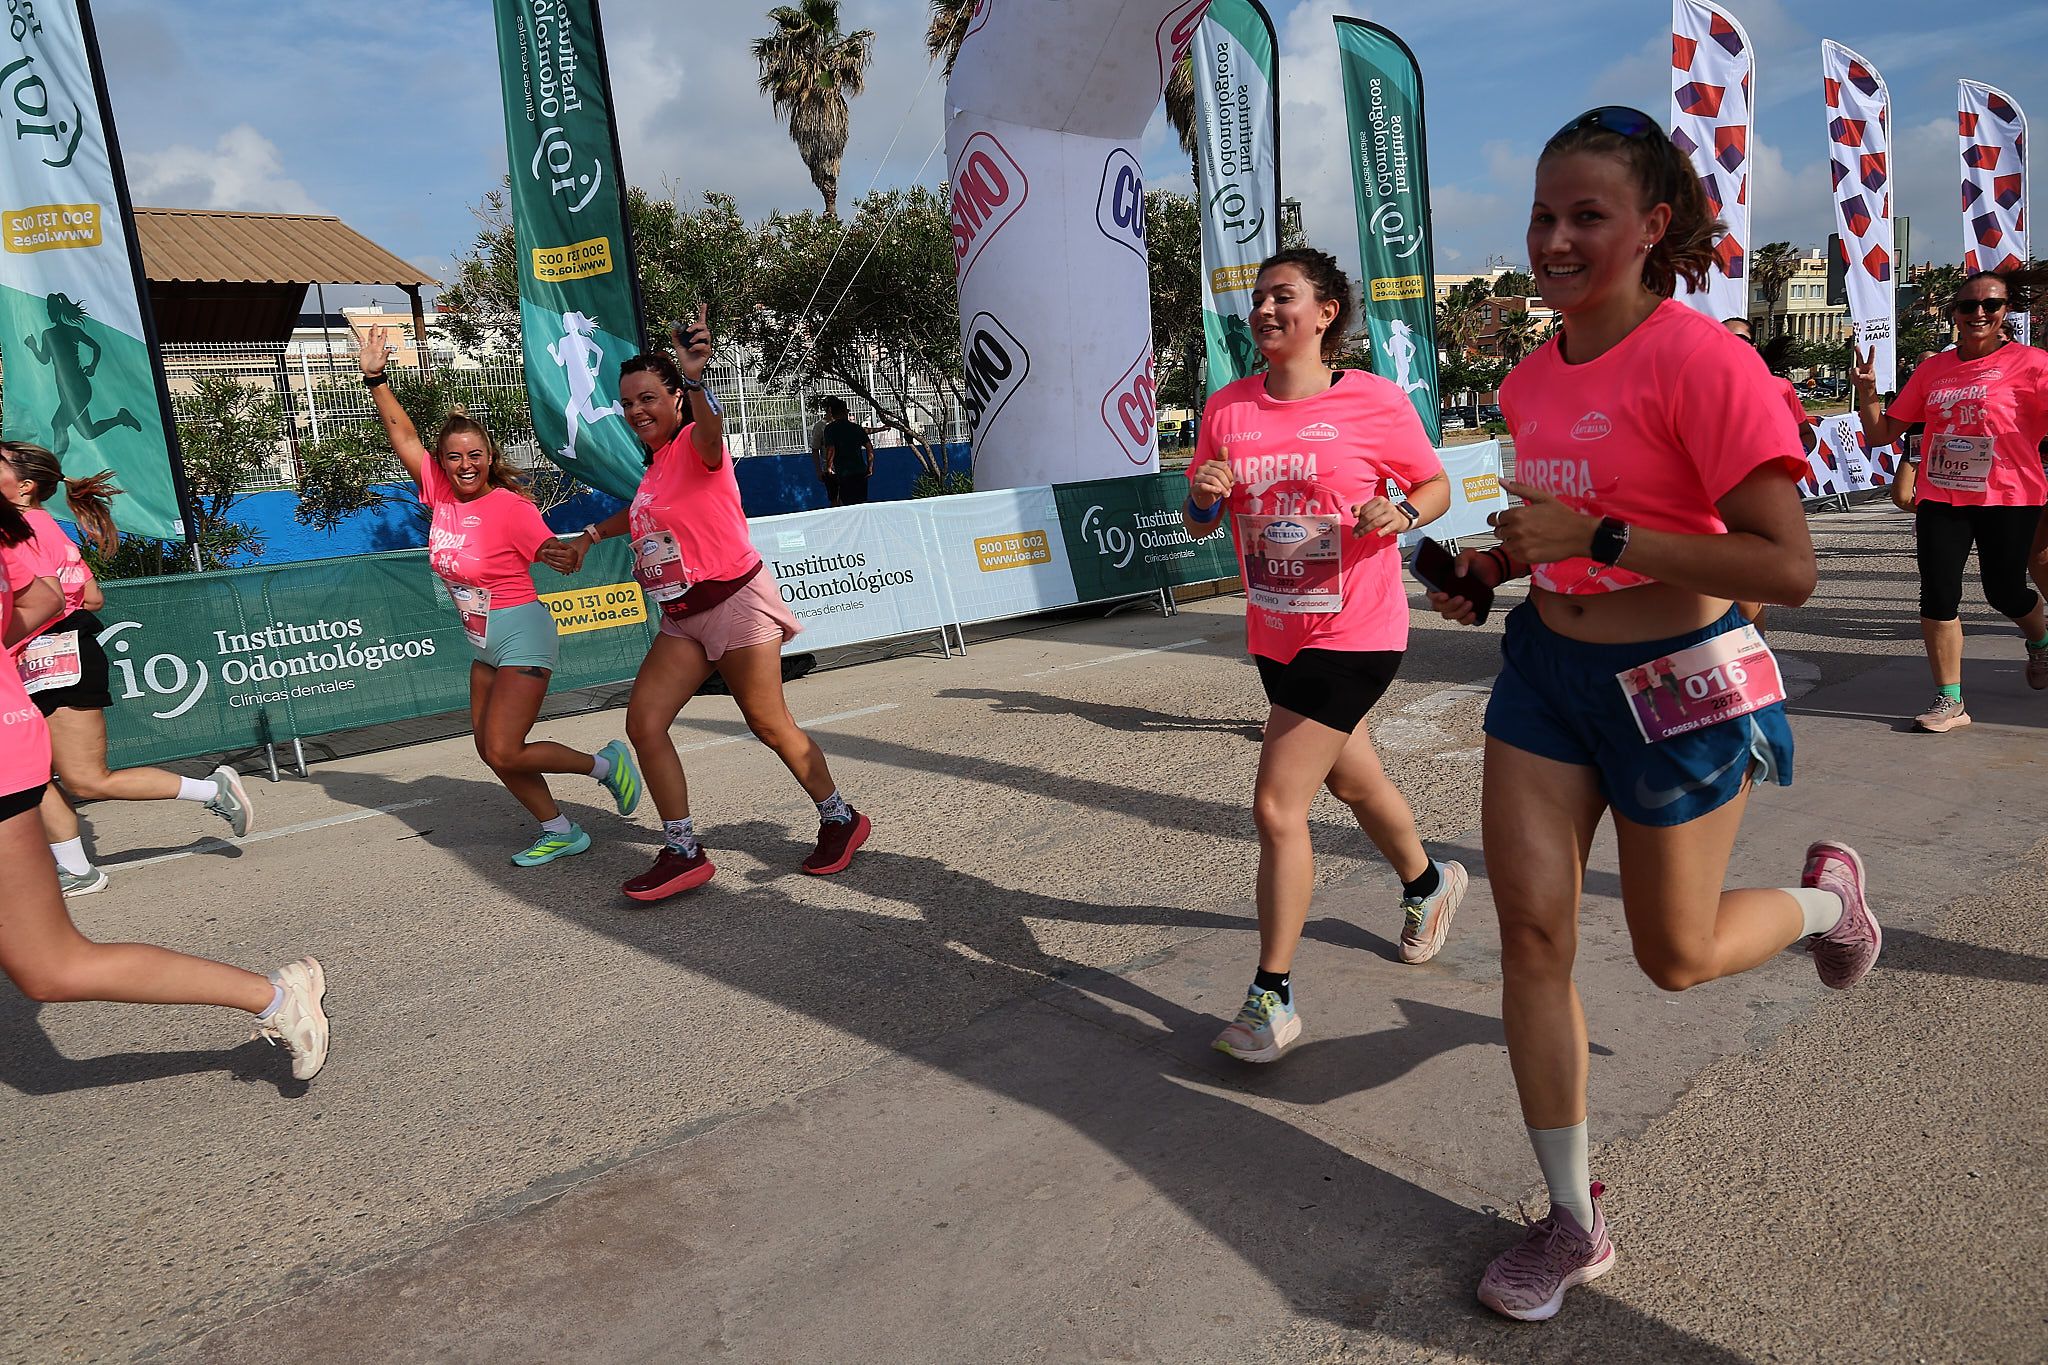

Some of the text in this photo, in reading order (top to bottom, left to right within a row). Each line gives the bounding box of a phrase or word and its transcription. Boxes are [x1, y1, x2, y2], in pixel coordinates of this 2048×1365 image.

[952, 150, 1010, 277] SMO
[965, 329, 1013, 447] SMO
[1927, 384, 1988, 406] CARRERA
[1223, 431, 1262, 444] OYSHO
[1229, 452, 1318, 485] ARRERA
[1944, 460, 1969, 471] 016
[1132, 509, 1184, 530] Institut
[1266, 528, 1304, 539] ASTURIANA
[980, 535, 1044, 554] 900 131 002
[771, 551, 866, 580] Institutos
[983, 549, 1046, 566] www.ioa.es
[1268, 560, 1305, 576] 016
[644, 564, 663, 579] 016
[779, 567, 915, 603] Odontológicos
[577, 594, 601, 609] 131
[605, 589, 637, 605] 002
[1255, 593, 1279, 605] OYSHO
[790, 599, 865, 621] línicas dentales
[213, 617, 363, 656] Institutos
[28, 656, 55, 671] 016
[221, 637, 436, 686] Odontológicos
[1685, 660, 1748, 699] 016
[229, 677, 356, 709] Clínicas dentales
[1711, 691, 1743, 710] 2873
[1662, 719, 1701, 738] CARRERA
[1701, 717, 1713, 726] DE
[1713, 712, 1726, 722] LA
